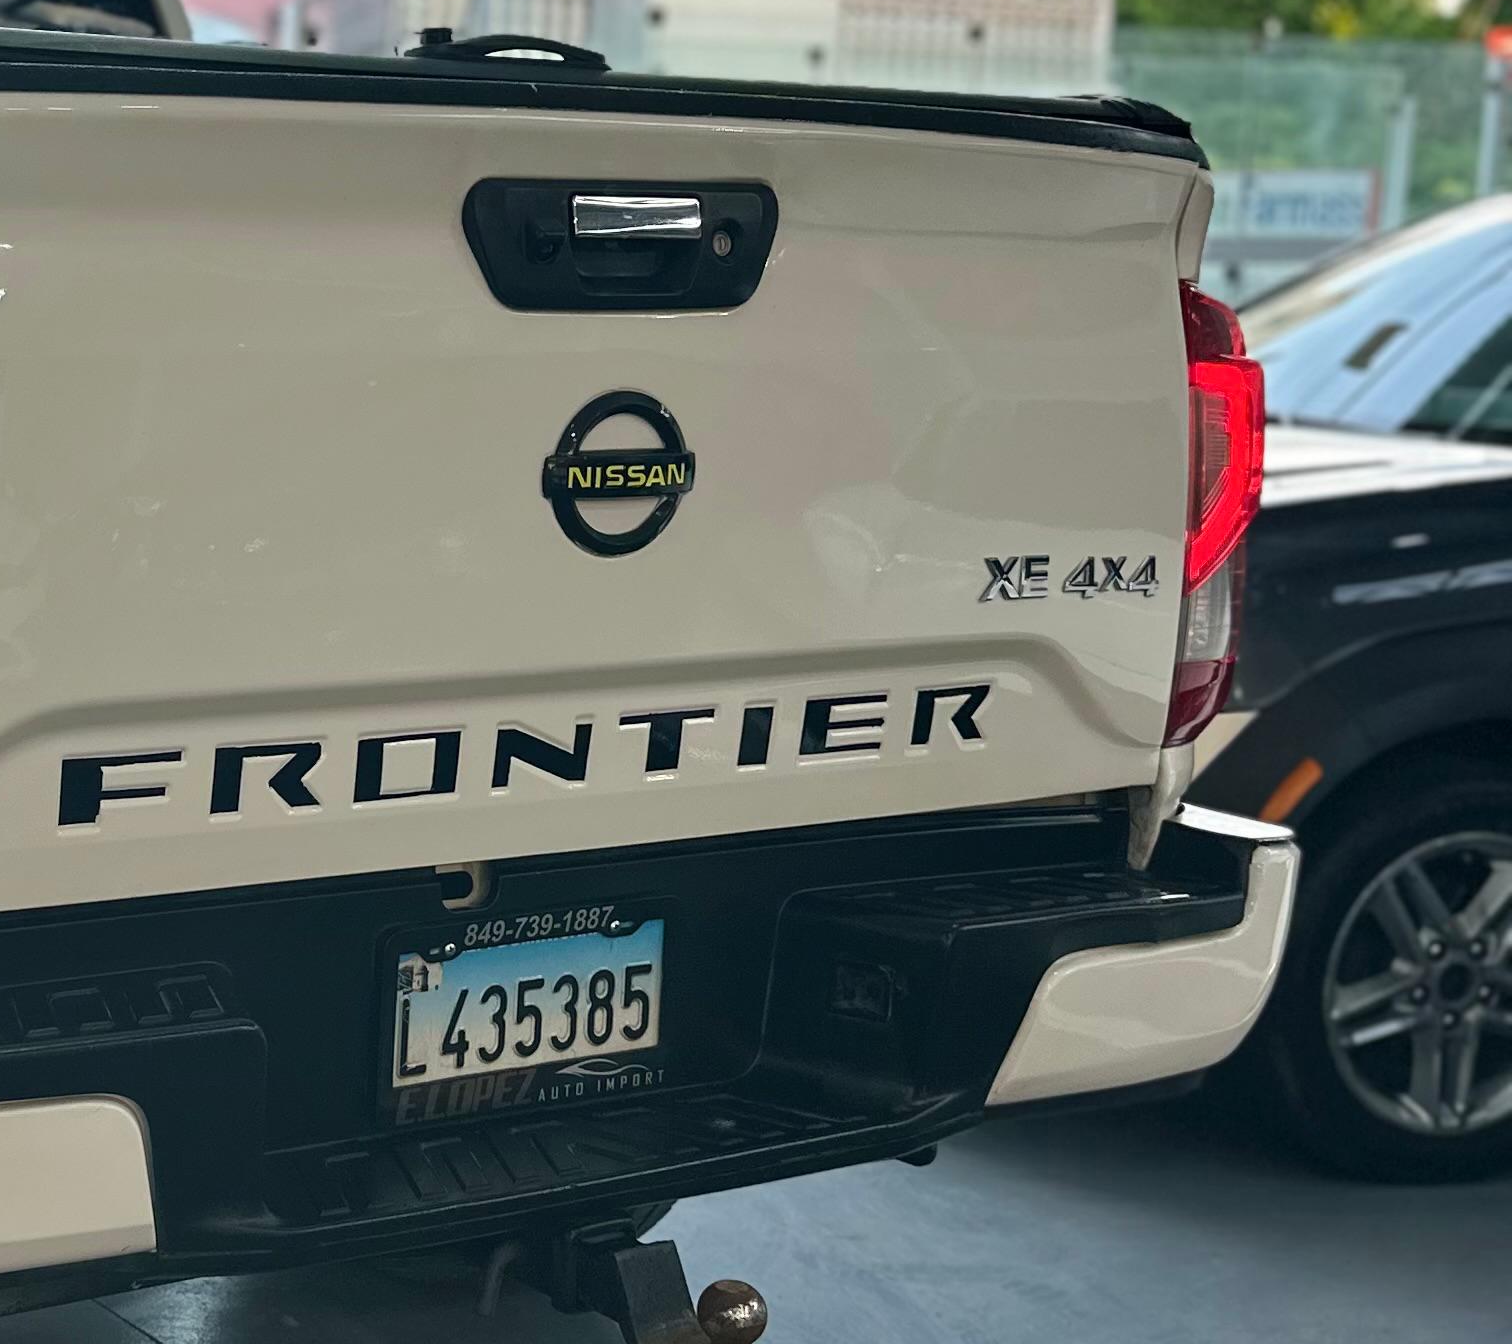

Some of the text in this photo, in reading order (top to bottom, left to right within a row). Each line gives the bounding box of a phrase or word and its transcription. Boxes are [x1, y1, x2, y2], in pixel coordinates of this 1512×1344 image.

[567, 462, 686, 489] NISSAN
[979, 554, 1160, 603] XE 4X4
[57, 682, 992, 834] FRONTIER
[463, 905, 615, 947] 849-739-1887
[397, 962, 653, 1078] L435385
[538, 1068, 665, 1103] AUTO IMPORT
